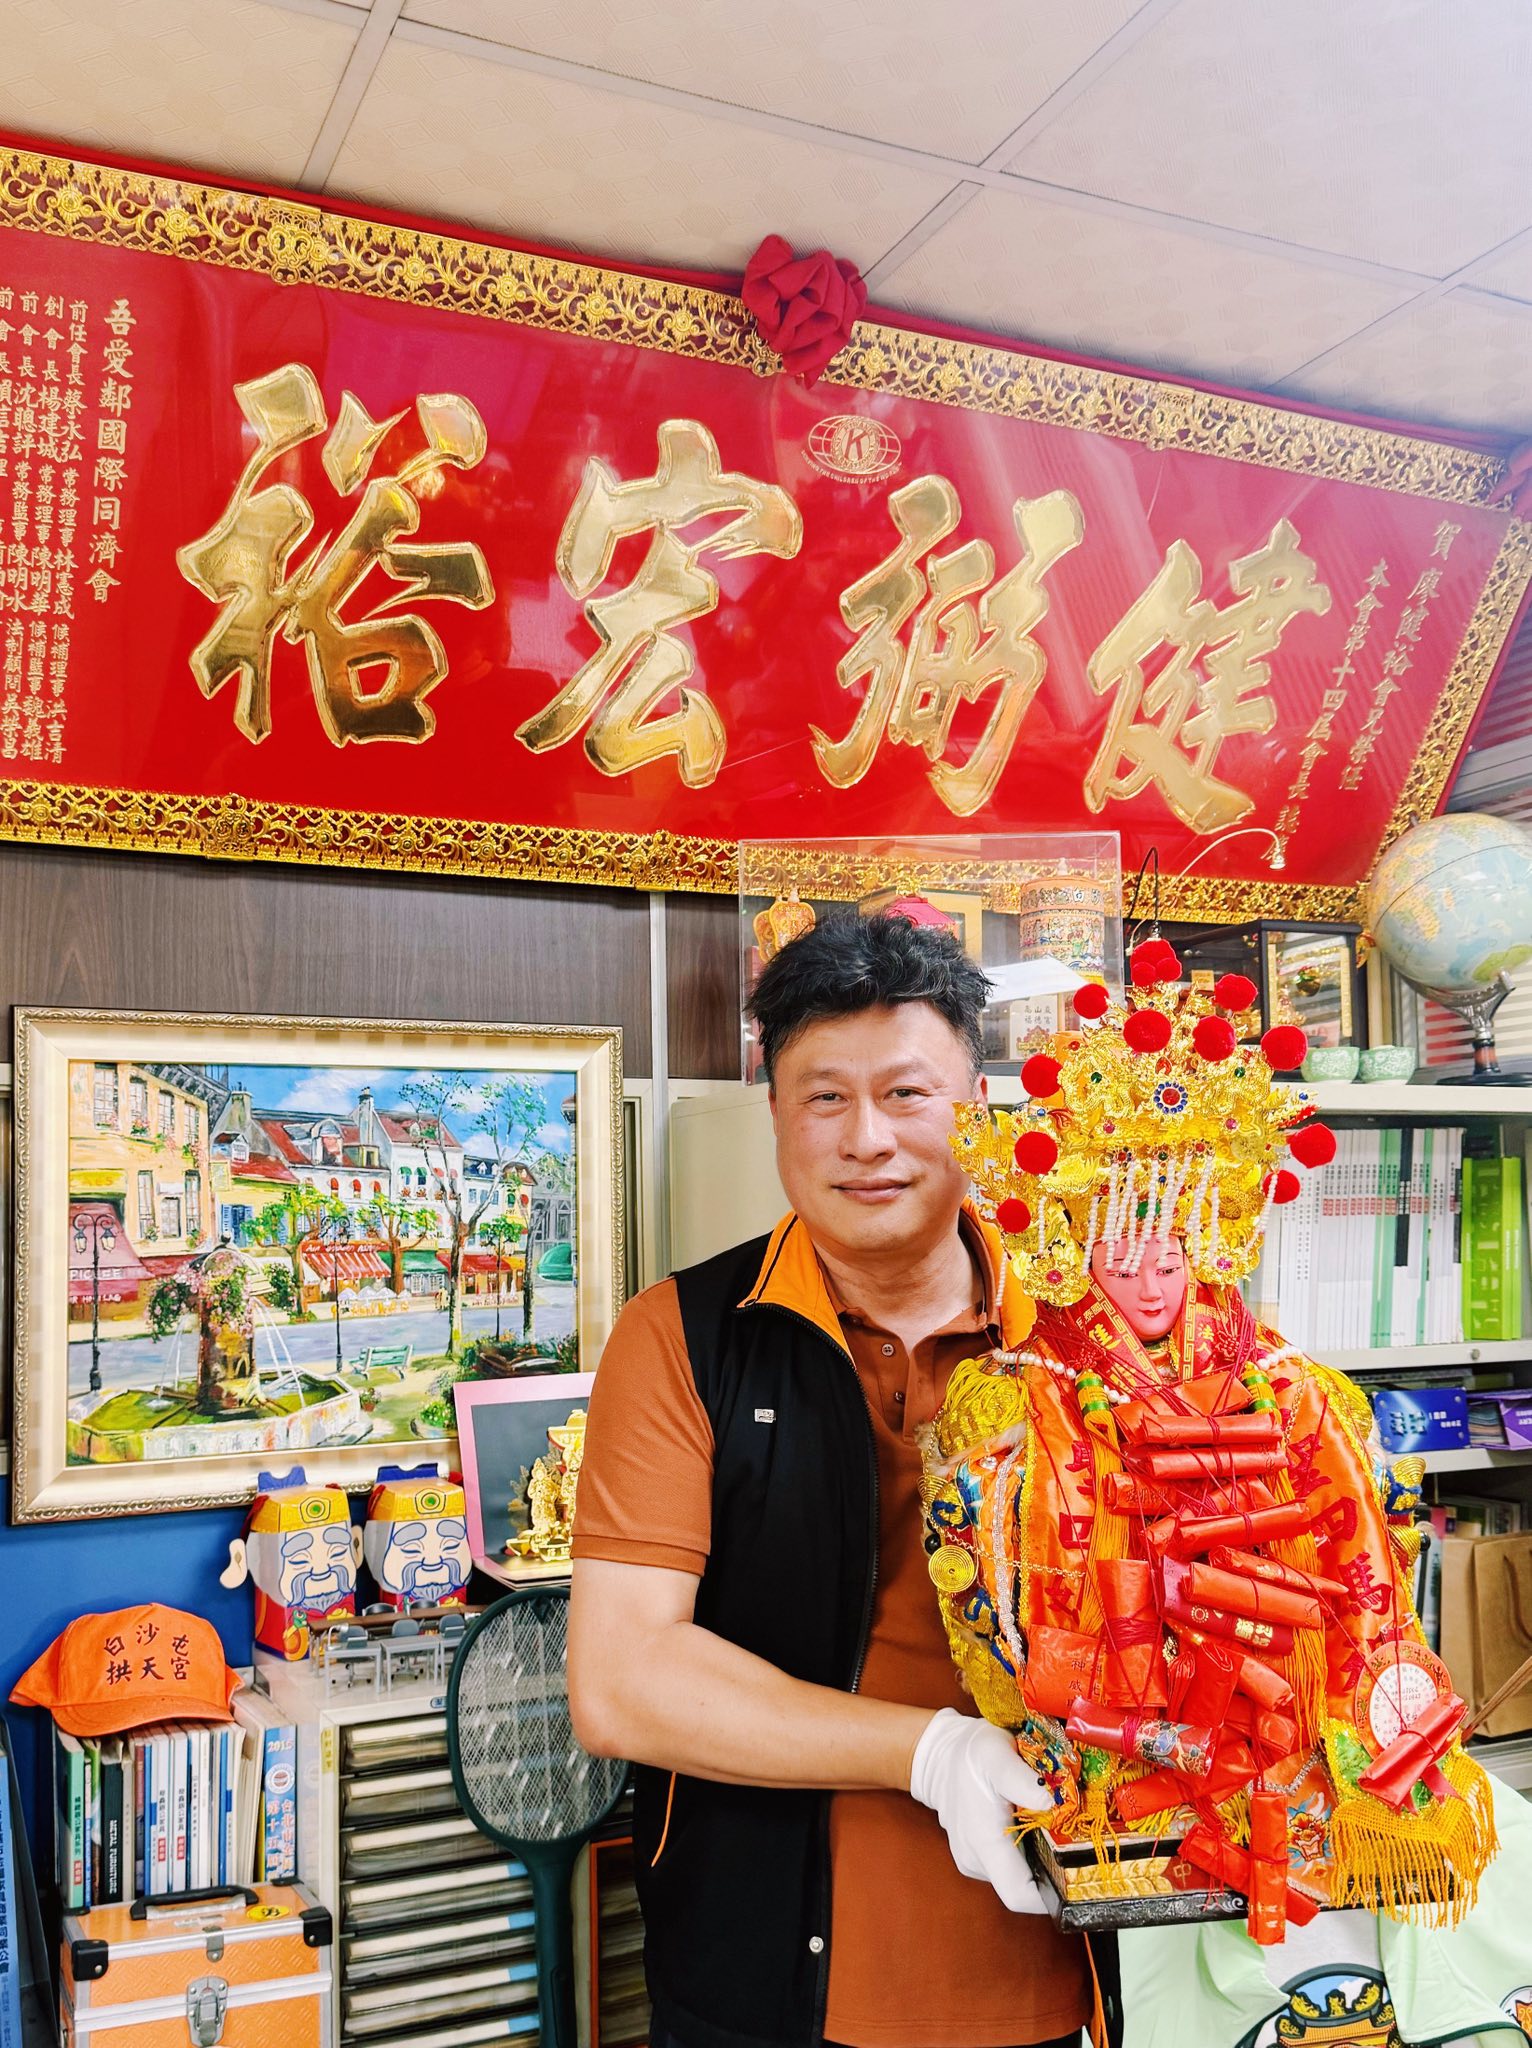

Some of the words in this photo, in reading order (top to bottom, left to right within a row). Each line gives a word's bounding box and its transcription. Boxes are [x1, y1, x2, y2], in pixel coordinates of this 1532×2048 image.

[103, 1622, 190, 1656] 白沙屯
[105, 1655, 191, 1685] 拱天宮
[109, 1819, 118, 1847] METAL
[109, 1847, 118, 1895] FURNITURE
